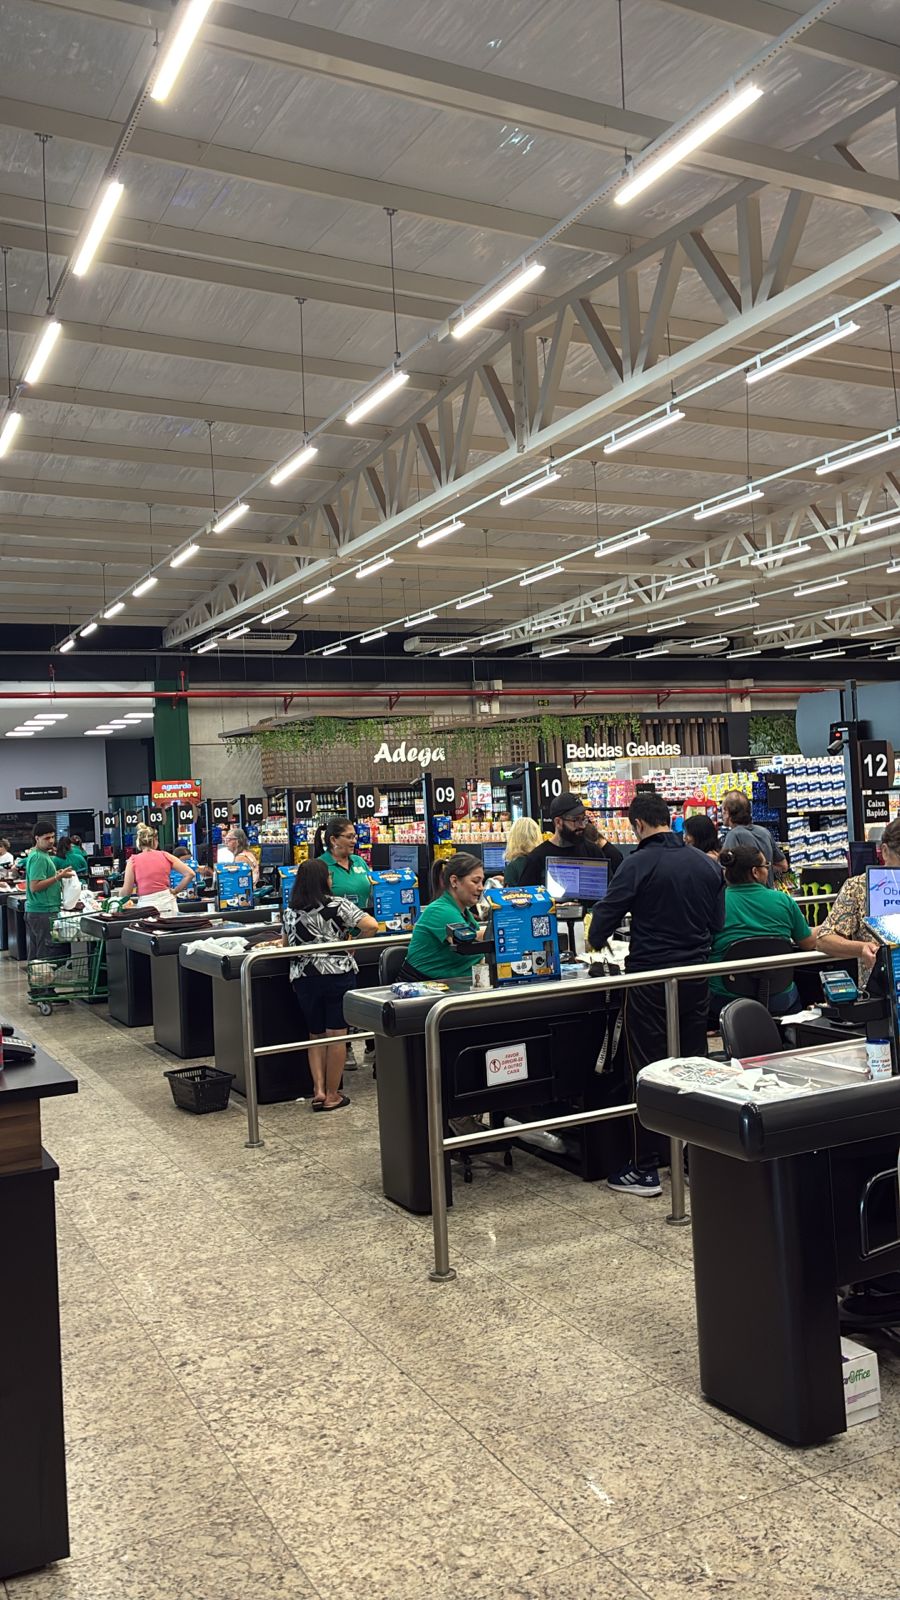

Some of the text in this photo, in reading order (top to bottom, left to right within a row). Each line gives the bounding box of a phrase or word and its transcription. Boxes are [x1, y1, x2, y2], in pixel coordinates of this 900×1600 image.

[373, 741, 446, 768] Adega
[566, 741, 682, 759] Bebidas Geladas
[864, 753, 888, 777] 12
[541, 778, 562, 797] 10
[153, 790, 199, 799] caixa livre
[435, 786, 455, 803] 09
[295, 799, 312, 813] 07
[357, 794, 375, 809] 08
[867, 800, 886, 808] Caixa
[179, 810, 193, 820] 04
[213, 807, 228, 818] 05
[247, 803, 263, 815] 06
[104, 816, 115, 825] 01
[126, 815, 138, 824] 02
[150, 812, 163, 822] 03
